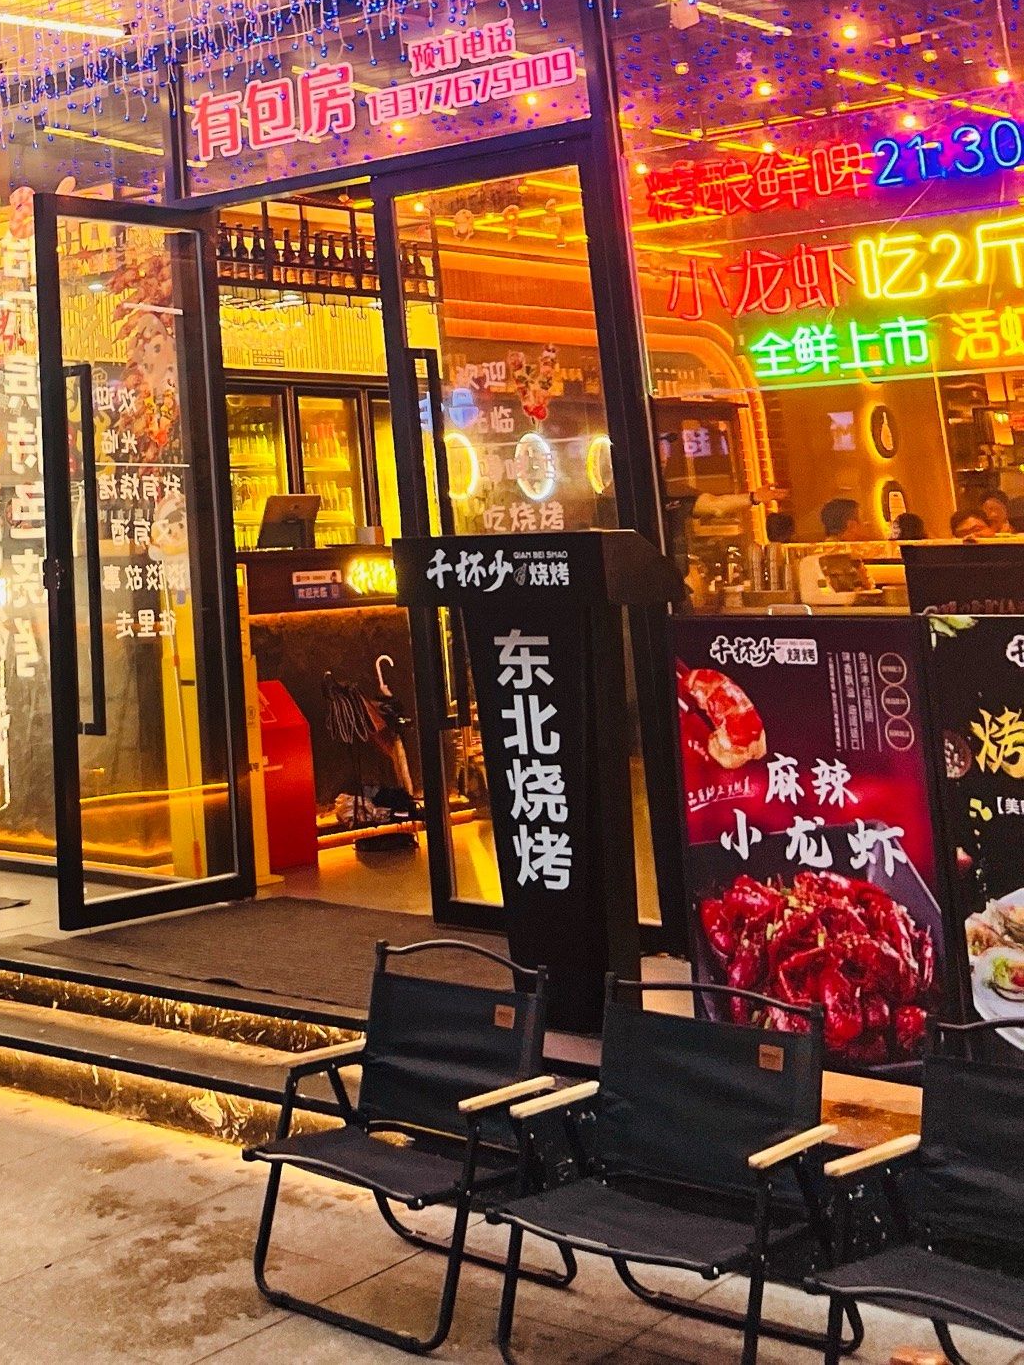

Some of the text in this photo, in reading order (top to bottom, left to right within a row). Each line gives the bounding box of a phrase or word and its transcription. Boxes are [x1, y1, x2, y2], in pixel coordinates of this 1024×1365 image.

[409, 18, 516, 78] 预订电话
[192, 61, 356, 161] 有包房
[366, 48, 578, 126] 13377675909
[647, 143, 869, 223] 精酿鲜啤
[750, 316, 930, 379] 全鲜上市
[483, 501, 566, 532] 吃烧烤
[426, 548, 514, 592] 千杯少
[528, 561, 570, 586] 烧烤
[710, 636, 777, 667] 千杯少
[493, 629, 574, 890] 东北烧烤
[766, 752, 859, 811] 麻辣
[720, 808, 908, 878] 小龙虾
